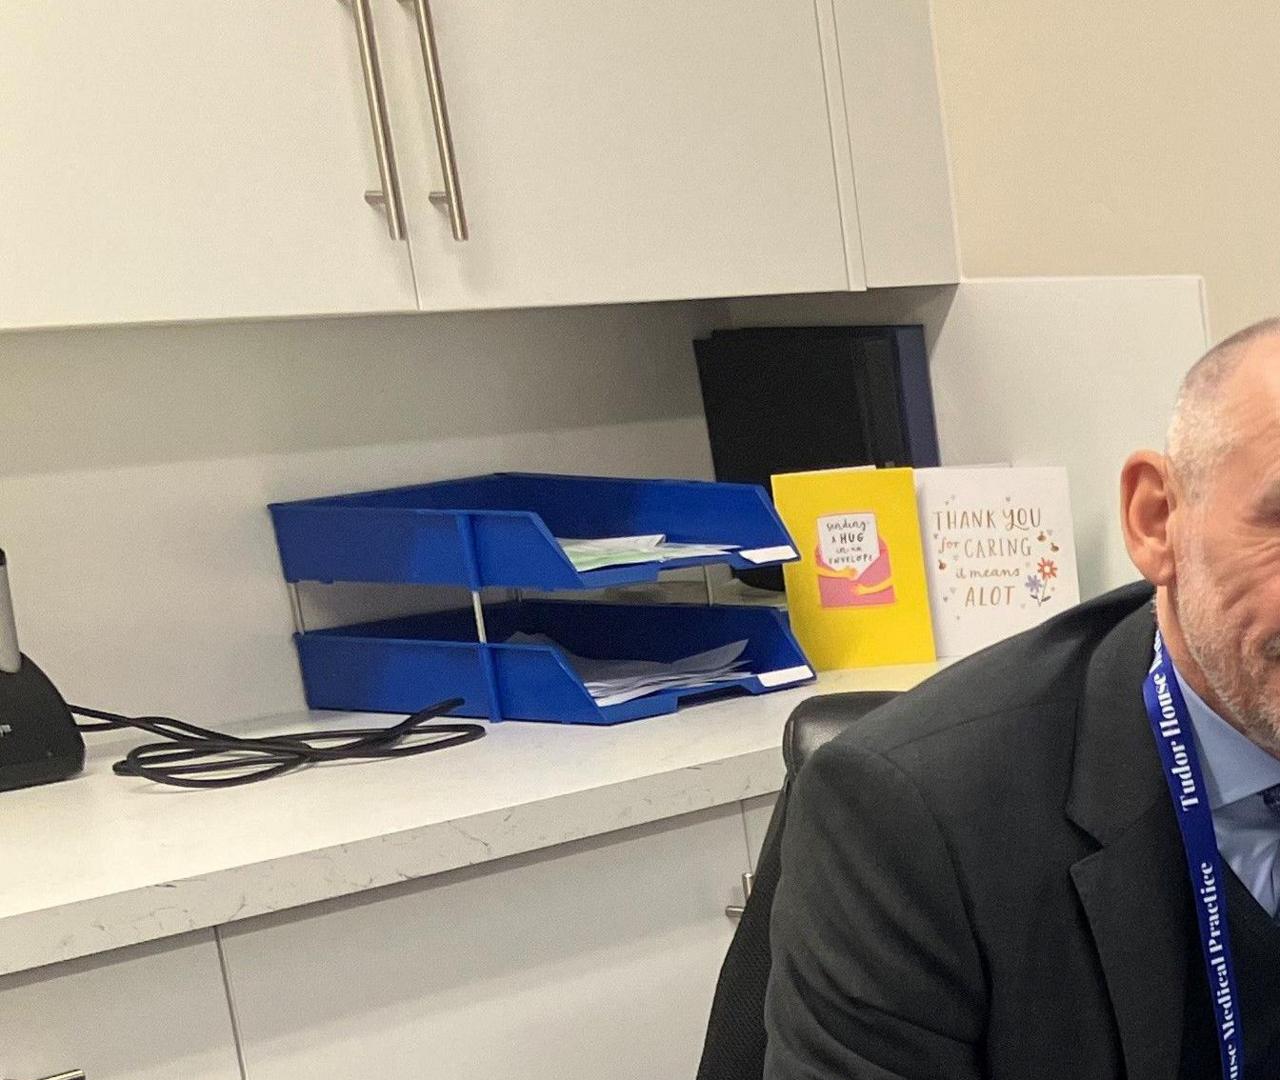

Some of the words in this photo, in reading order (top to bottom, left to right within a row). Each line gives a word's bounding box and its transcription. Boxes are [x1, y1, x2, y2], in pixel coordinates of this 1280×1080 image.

[934, 510, 996, 531] THANK
[1002, 507, 1042, 532] YOU
[840, 532, 864, 544] HUG
[938, 536, 958, 554] for
[964, 536, 1031, 559] CARING
[970, 567, 1020, 578] means
[965, 585, 1015, 608] ALOT
[1153, 672, 1181, 738] House
[1171, 740, 1200, 812] Tudor
[1200, 862, 1223, 954] Practice
[1210, 955, 1236, 1041] Medical
